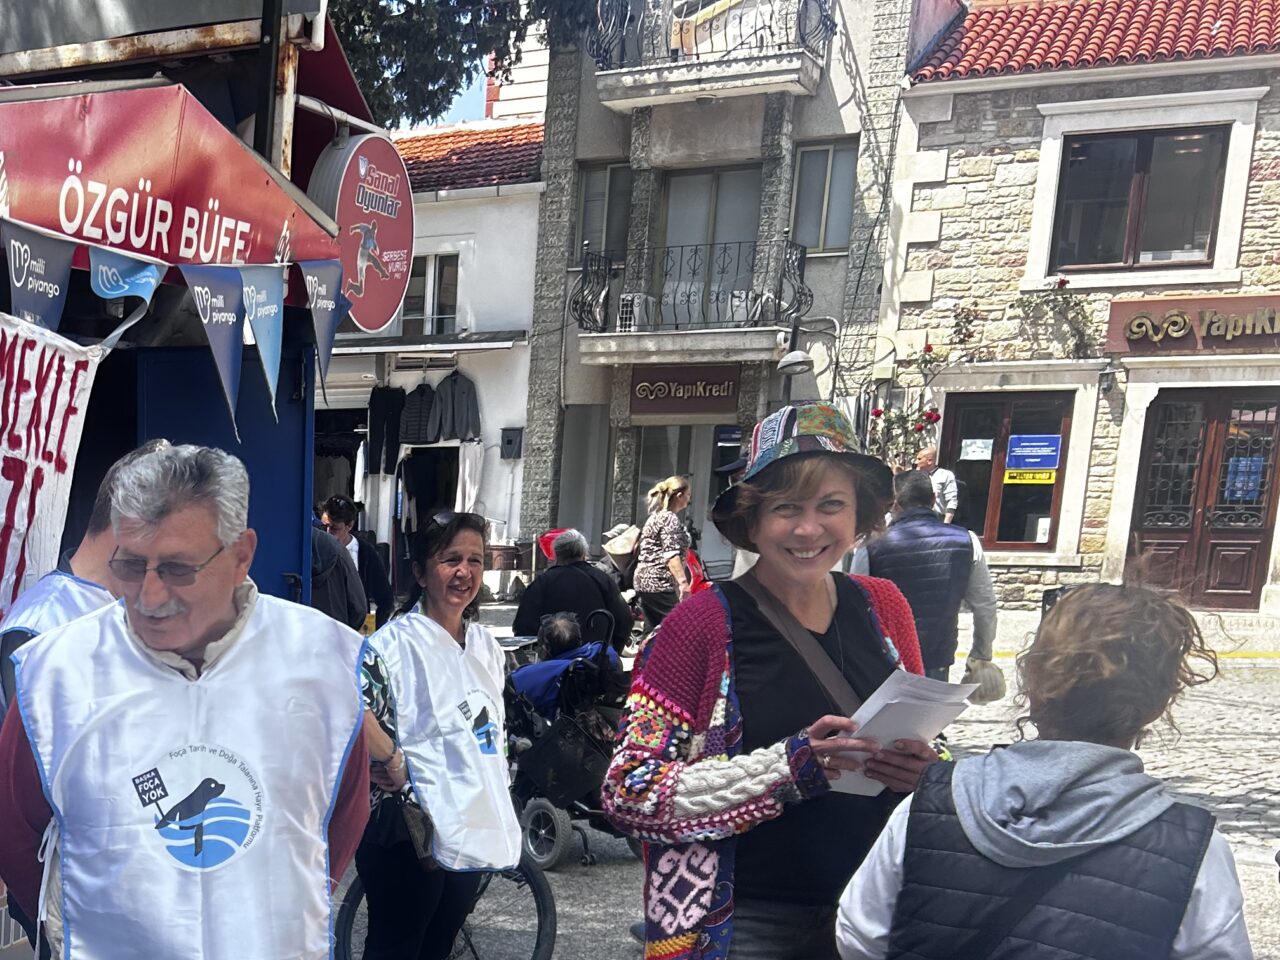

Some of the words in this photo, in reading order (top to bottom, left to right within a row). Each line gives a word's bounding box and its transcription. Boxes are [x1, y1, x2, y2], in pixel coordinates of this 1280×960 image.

[367, 164, 400, 196] Sanal
[355, 183, 401, 218] Oyunlar
[59, 157, 173, 254] ÖZGÜR
[179, 197, 251, 265] BÜFE
[29, 257, 46, 275] milli
[27, 274, 60, 297] piyango
[317, 284, 327, 295] milli
[211, 294, 225, 308] milli
[316, 297, 336, 312] piyango
[212, 309, 237, 325] piyango
[669, 380, 733, 399] YapıKredi
[169, 747, 187, 760] Foça
[189, 745, 207, 753] Tarih
[219, 749, 238, 765] Doğa
[134, 771, 156, 785] BAŞKA
[238, 761, 258, 791] Talanına
[138, 779, 161, 794] FOÇA
[142, 787, 165, 804] YOK
[243, 813, 264, 849] Platformu
